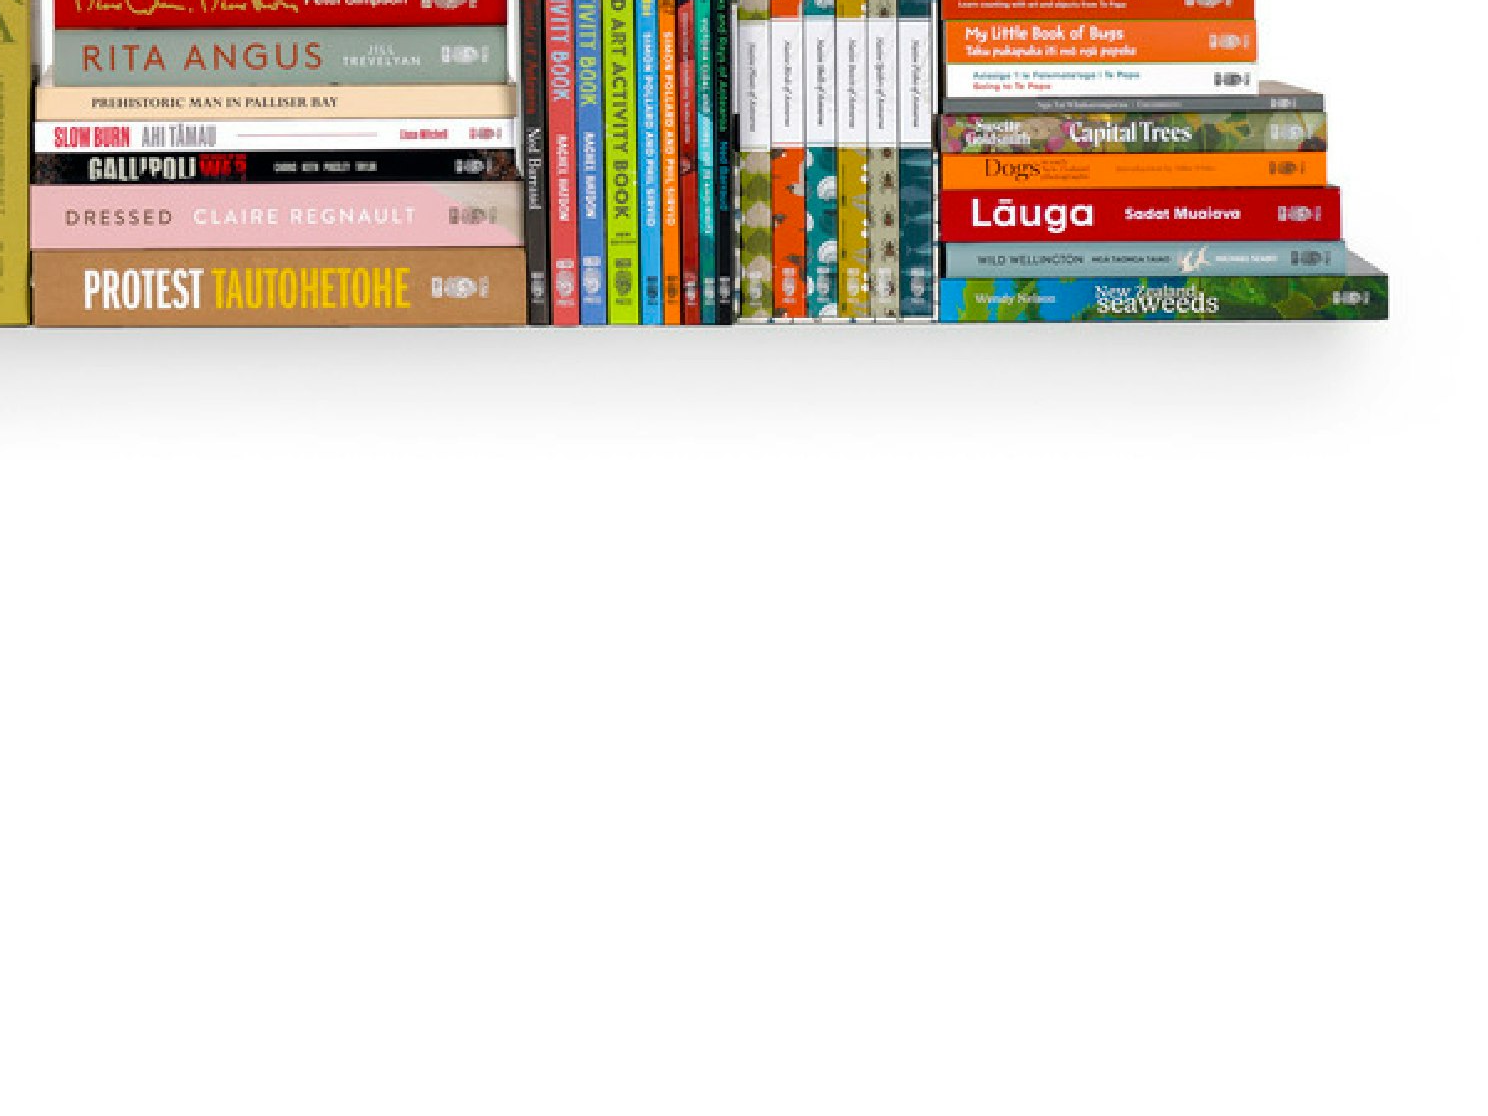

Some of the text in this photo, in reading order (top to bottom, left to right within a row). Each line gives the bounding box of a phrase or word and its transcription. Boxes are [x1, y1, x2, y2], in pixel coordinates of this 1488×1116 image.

[610, 18, 627, 57] ART
[965, 25, 1125, 42] My Little Book of Bugs
[82, 42, 323, 71] RITA ANGUS
[343, 55, 421, 68] TREVELYAN
[368, 44, 393, 56] JILL
[550, 50, 571, 102] BOOK
[578, 55, 597, 107] BOOK
[91, 96, 338, 109] PREHISTORIC MAN IN PALLISER BAY
[611, 62, 628, 154] ACTIVITY
[54, 123, 217, 148] SLOW BURN AHI TĀMAU
[1069, 122, 1193, 147] Capital Trees
[526, 126, 542, 210] Ned Barraud
[985, 158, 1041, 182] Dogs
[613, 160, 630, 219] BOOK
[65, 207, 416, 226] DRESSED CLAIRE REGNAULT
[972, 198, 1241, 234] Lāuga Sadat Muaiava
[977, 253, 1084, 265] WILD WELLINGTON
[84, 267, 411, 310] PROTEST TAUTOHETOHE
[975, 293, 1014, 307] Wendy
[1095, 283, 1197, 300] New Zealand
[1096, 292, 1220, 315] seaweeds
